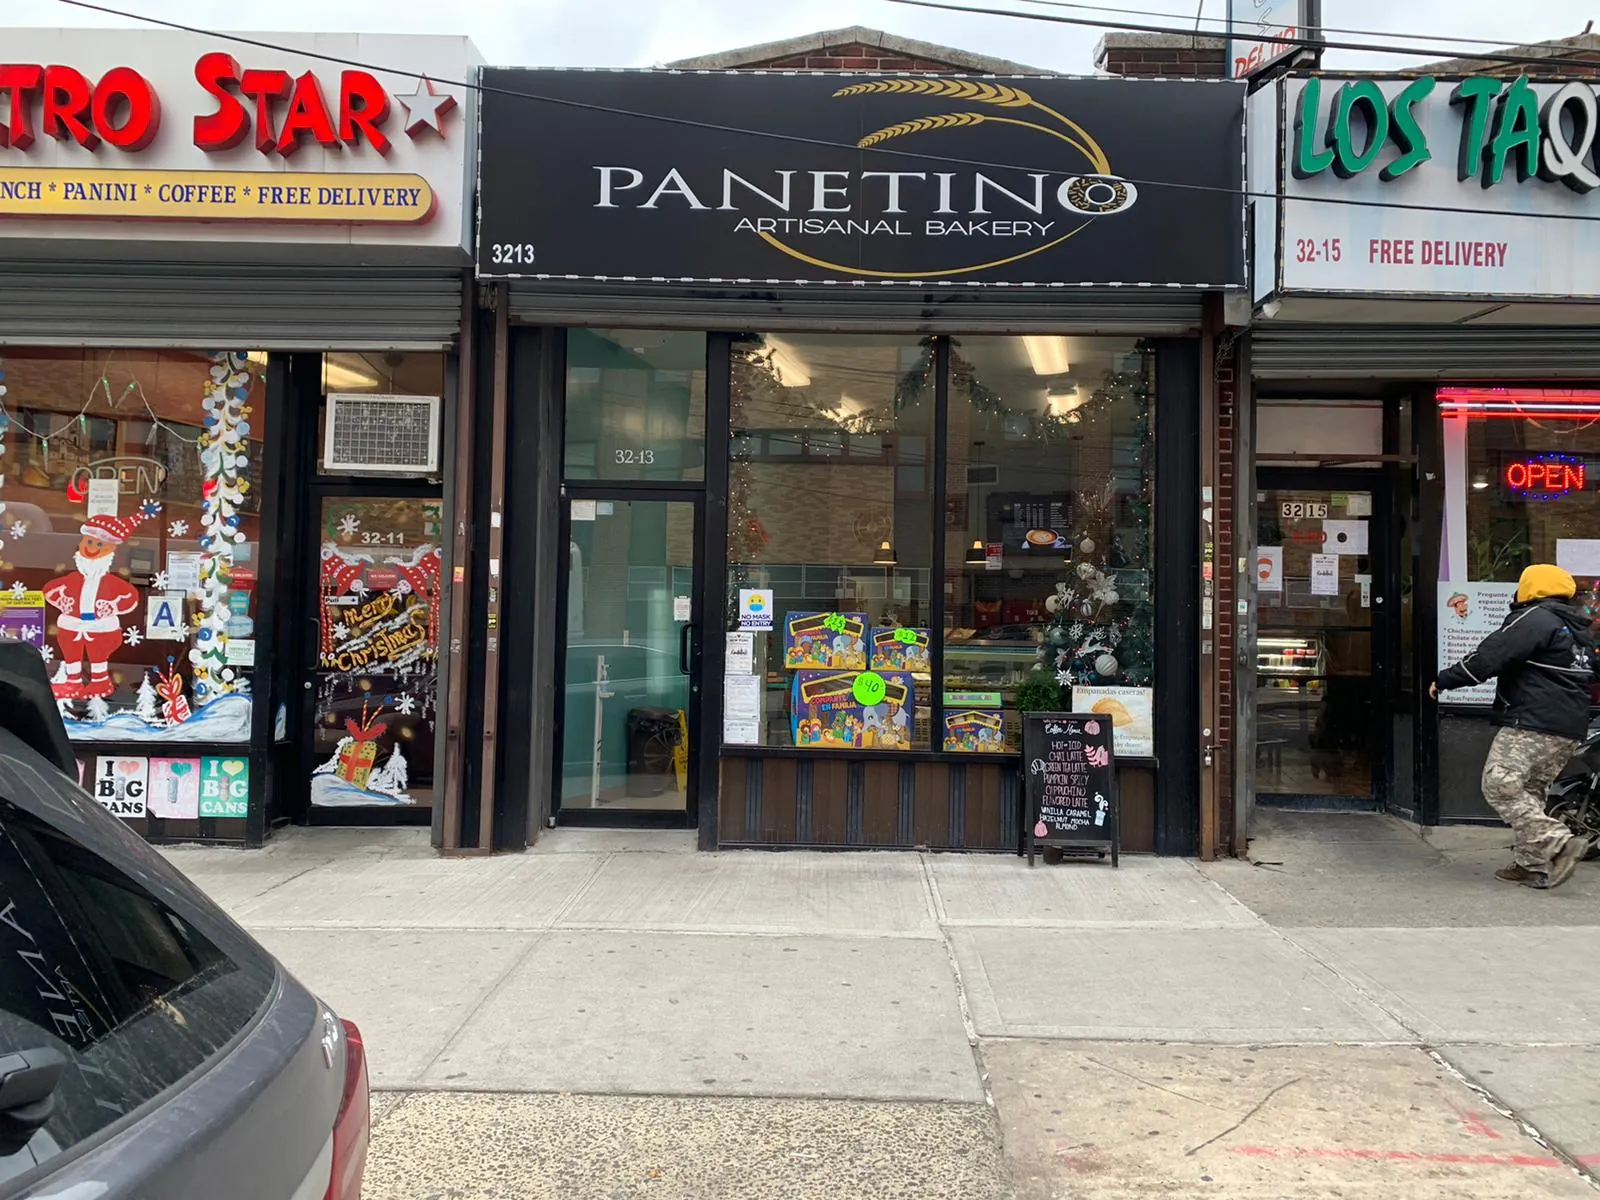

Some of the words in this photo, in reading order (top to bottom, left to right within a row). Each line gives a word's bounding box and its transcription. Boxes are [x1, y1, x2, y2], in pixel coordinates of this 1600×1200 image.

[0, 64, 160, 152] TRO
[194, 52, 392, 158] STAR
[1292, 76, 1436, 182] LOS
[1449, 74, 1600, 194] TAQ
[63, 182, 137, 202] PANINI
[158, 184, 237, 204] COFFEE
[257, 187, 312, 205] FREE
[317, 188, 422, 206] DELIVERY
[592, 165, 1138, 216] PANETINO
[733, 217, 913, 236] ARTISANAL
[926, 220, 1056, 237] BAKERY
[491, 244, 535, 265] 3213
[1296, 239, 1342, 263] 32-15
[1369, 239, 1415, 265] FREE
[1421, 240, 1509, 267] DELIVERY
[615, 450, 655, 464] 32-13
[1507, 463, 1584, 490] OPEN
[361, 532, 404, 544] 32-11
[153, 602, 175, 626] A
[1077, 687, 1117, 697] Empanadas
[200, 802, 248, 814] CANS
